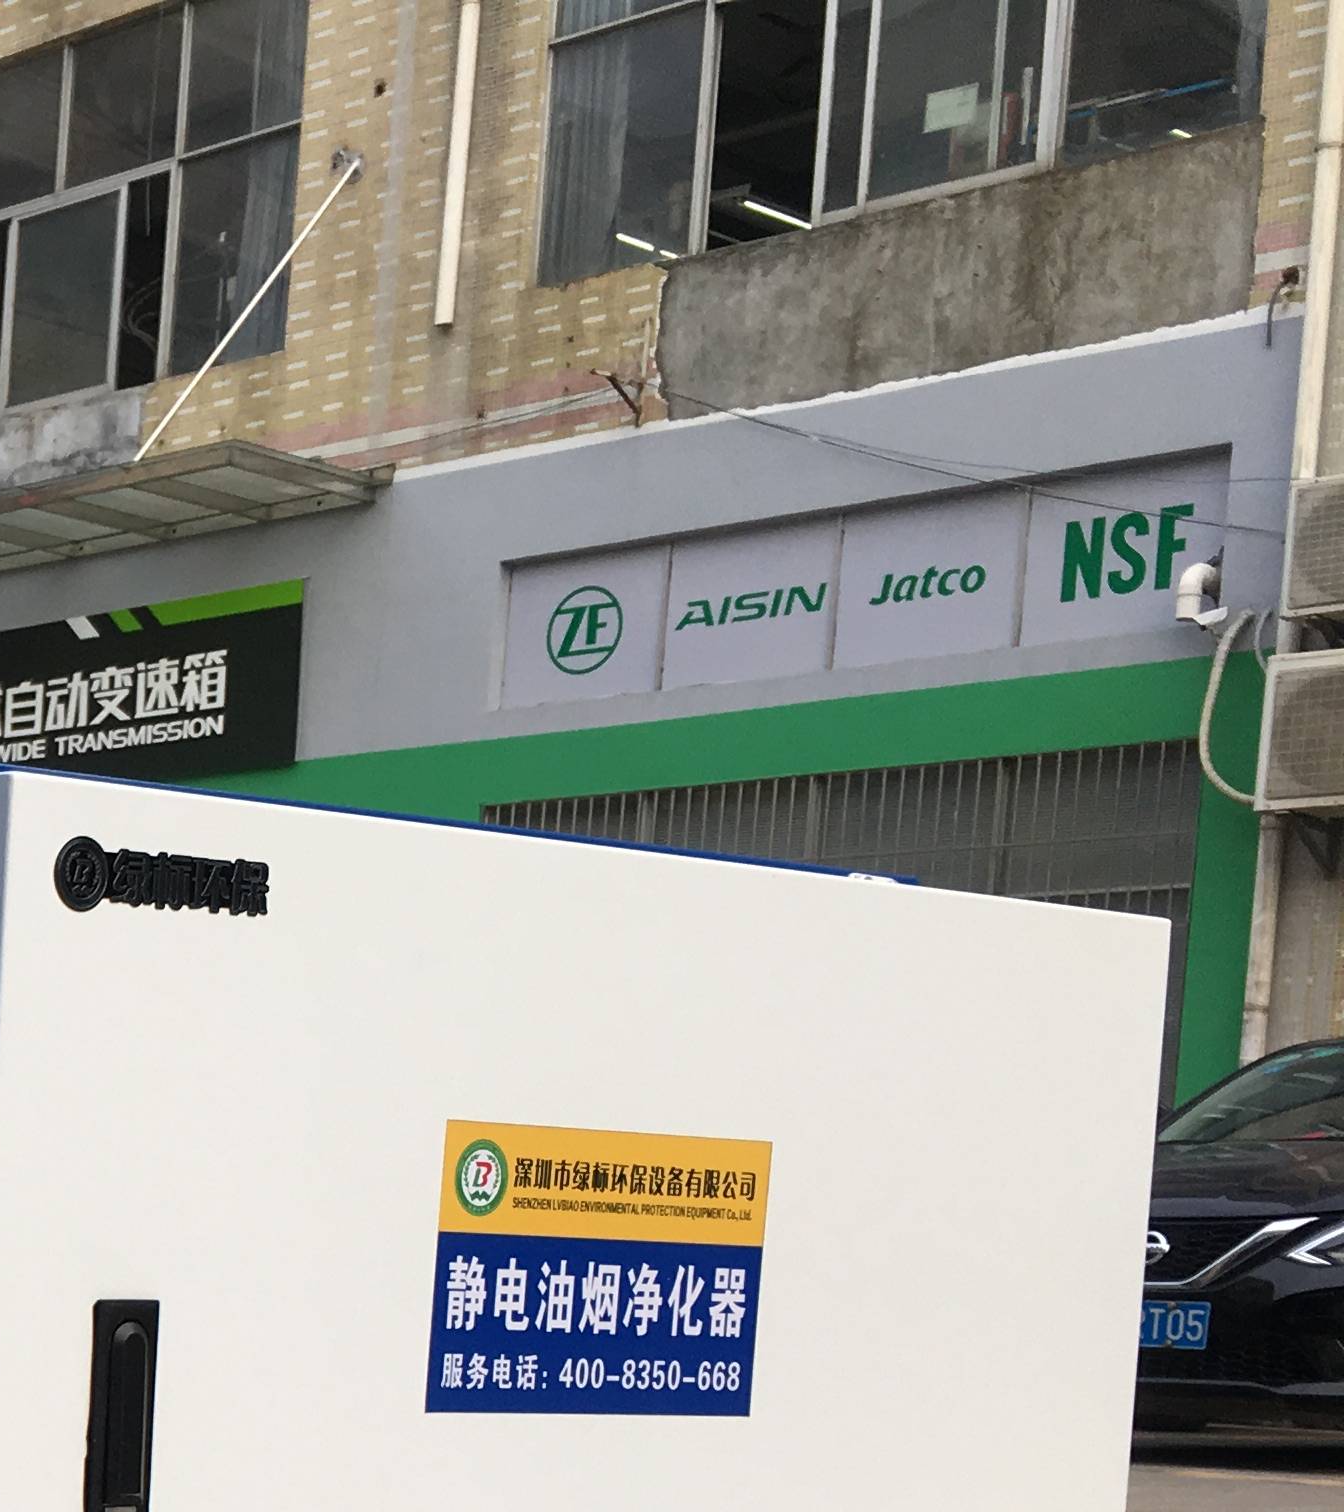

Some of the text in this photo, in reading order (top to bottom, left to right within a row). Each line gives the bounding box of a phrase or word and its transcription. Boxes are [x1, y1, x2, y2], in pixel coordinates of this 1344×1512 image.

[1060, 503, 1195, 603] NSF
[675, 581, 829, 631] AISIN
[869, 564, 986, 606] Jatco
[555, 602, 616, 659] ZF
[54, 715, 224, 757] TRANSMISSION
[513, 1157, 757, 1201] 深圳市绿标环保设备有限公司
[512, 1197, 551, 1210] SHENZHEN
[580, 1201, 640, 1216] ENVIRONMENTAL
[641, 1204, 686, 1217] PROTECTION
[686, 1207, 726, 1220] EQUIPMENT
[446, 1255, 747, 1338] 静电油烟净化器
[1141, 1307, 1205, 1341] T05
[559, 1358, 742, 1392] 400-8350-668
